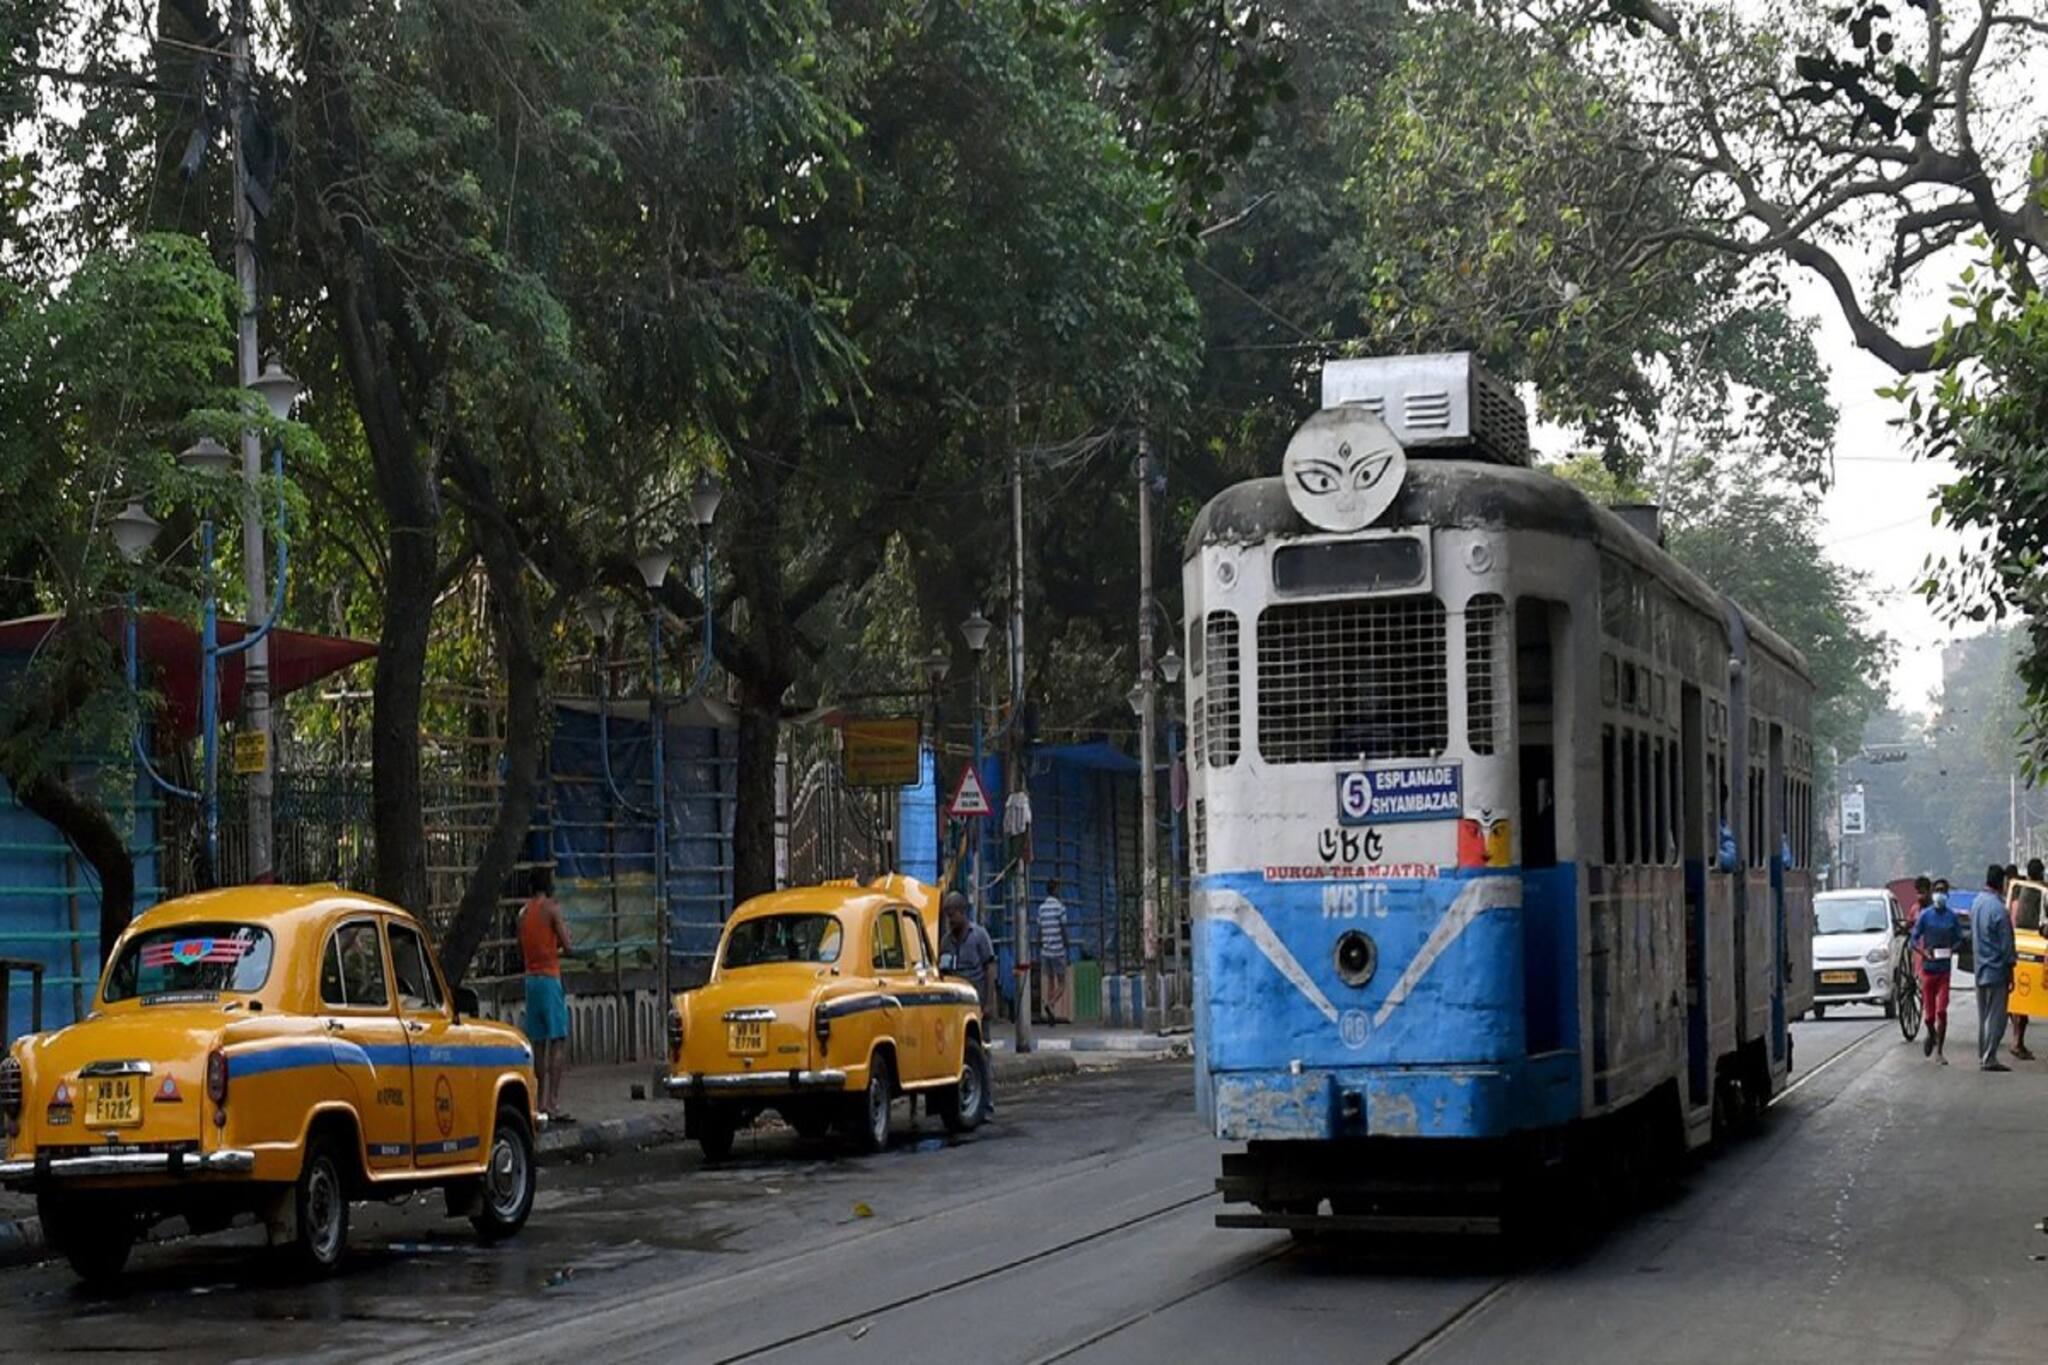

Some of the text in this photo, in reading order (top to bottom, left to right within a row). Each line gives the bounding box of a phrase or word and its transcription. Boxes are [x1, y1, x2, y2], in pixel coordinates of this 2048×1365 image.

[1376, 767, 1453, 790] ESPLANADE
[1349, 780, 1365, 809] 5
[1371, 791, 1458, 814] SHYAMBAZAR
[1265, 863, 1438, 879] DURGA TRAMJATRA
[1322, 883, 1389, 919] WBTC
[98, 1079, 131, 1099] WB 04
